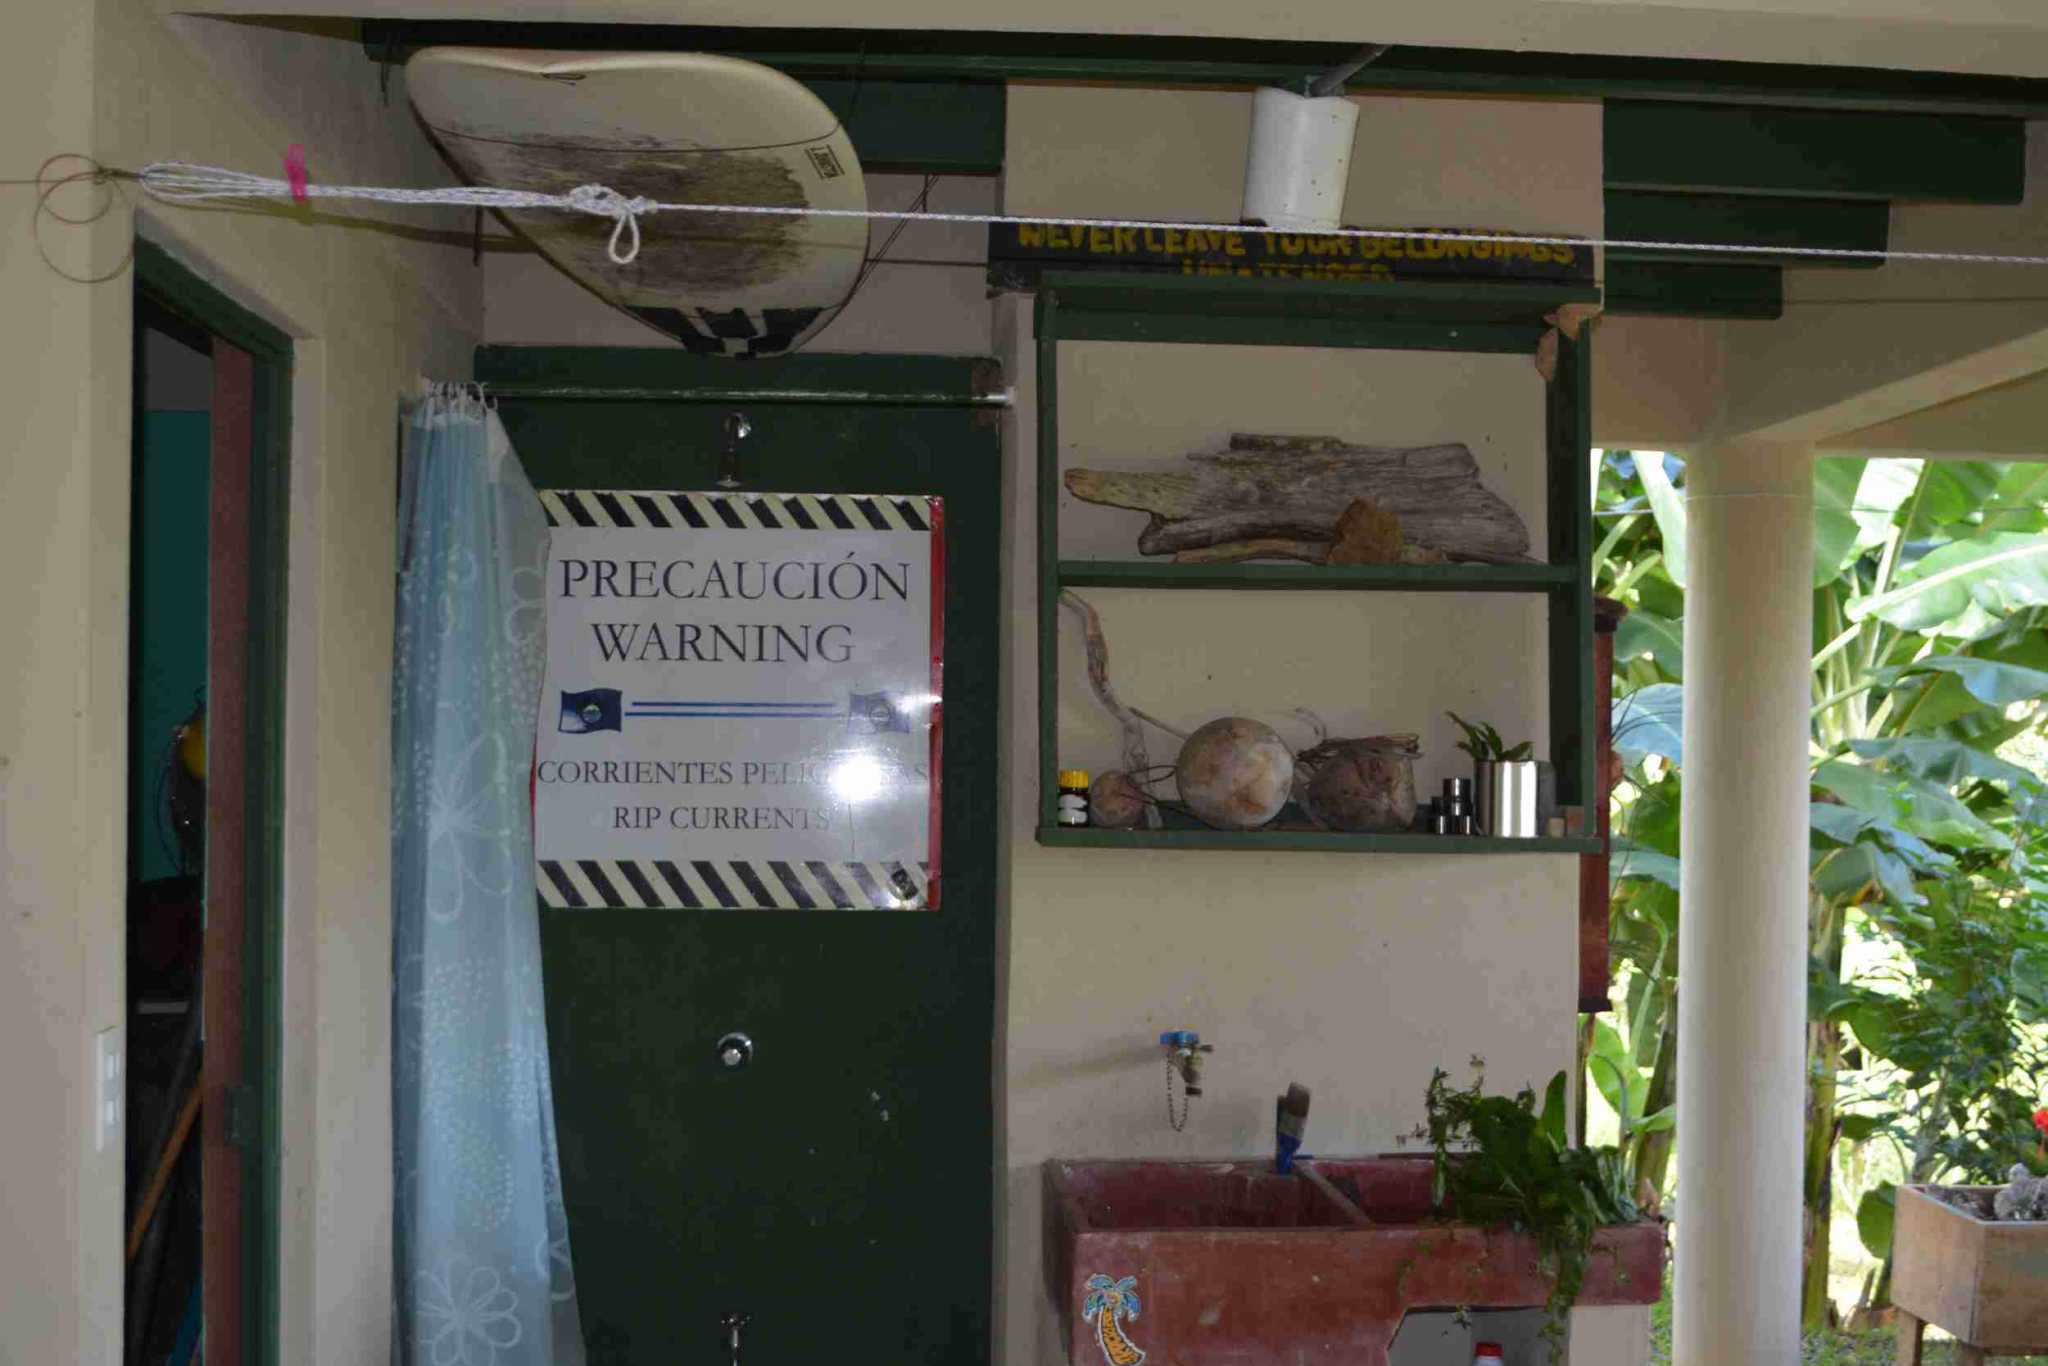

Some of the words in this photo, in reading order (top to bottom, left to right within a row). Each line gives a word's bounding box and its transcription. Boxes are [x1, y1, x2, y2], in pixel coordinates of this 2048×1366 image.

[1143, 226, 1246, 256] LEAVE
[558, 551, 912, 601] PRECAUCIÓN
[590, 622, 857, 663] WARNING
[537, 760, 734, 784] CORRIENTES
[742, 762, 928, 786] PELIGAS
[613, 806, 662, 829] RIP
[670, 806, 831, 831] CURRENTS
